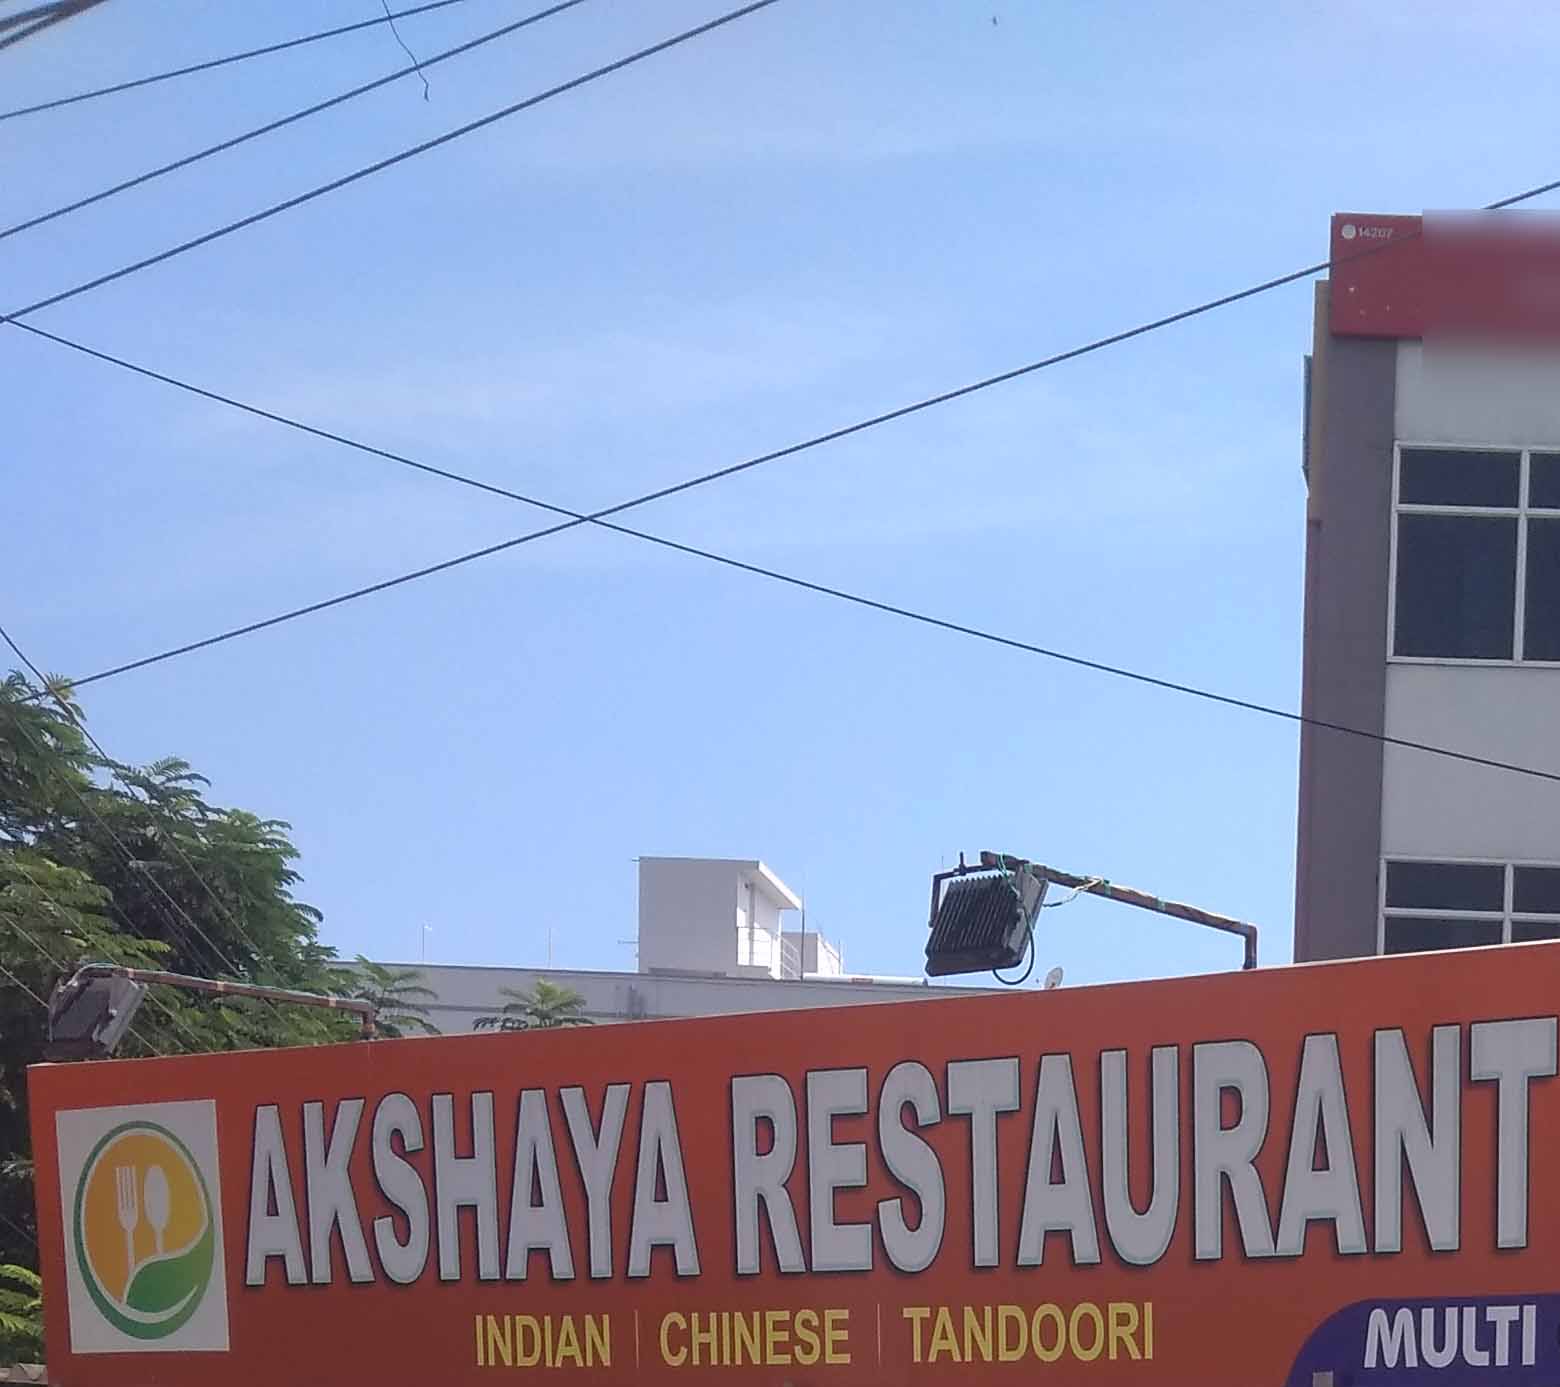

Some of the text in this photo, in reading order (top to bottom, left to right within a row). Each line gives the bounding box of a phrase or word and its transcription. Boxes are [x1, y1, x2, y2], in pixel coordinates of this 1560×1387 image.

[245, 1016, 1560, 1286] AKSHAYA RESTAURANT
[475, 1302, 1154, 1369] INDIAN CHINESE TANDOORI
[1364, 1303, 1537, 1370] MULTI
